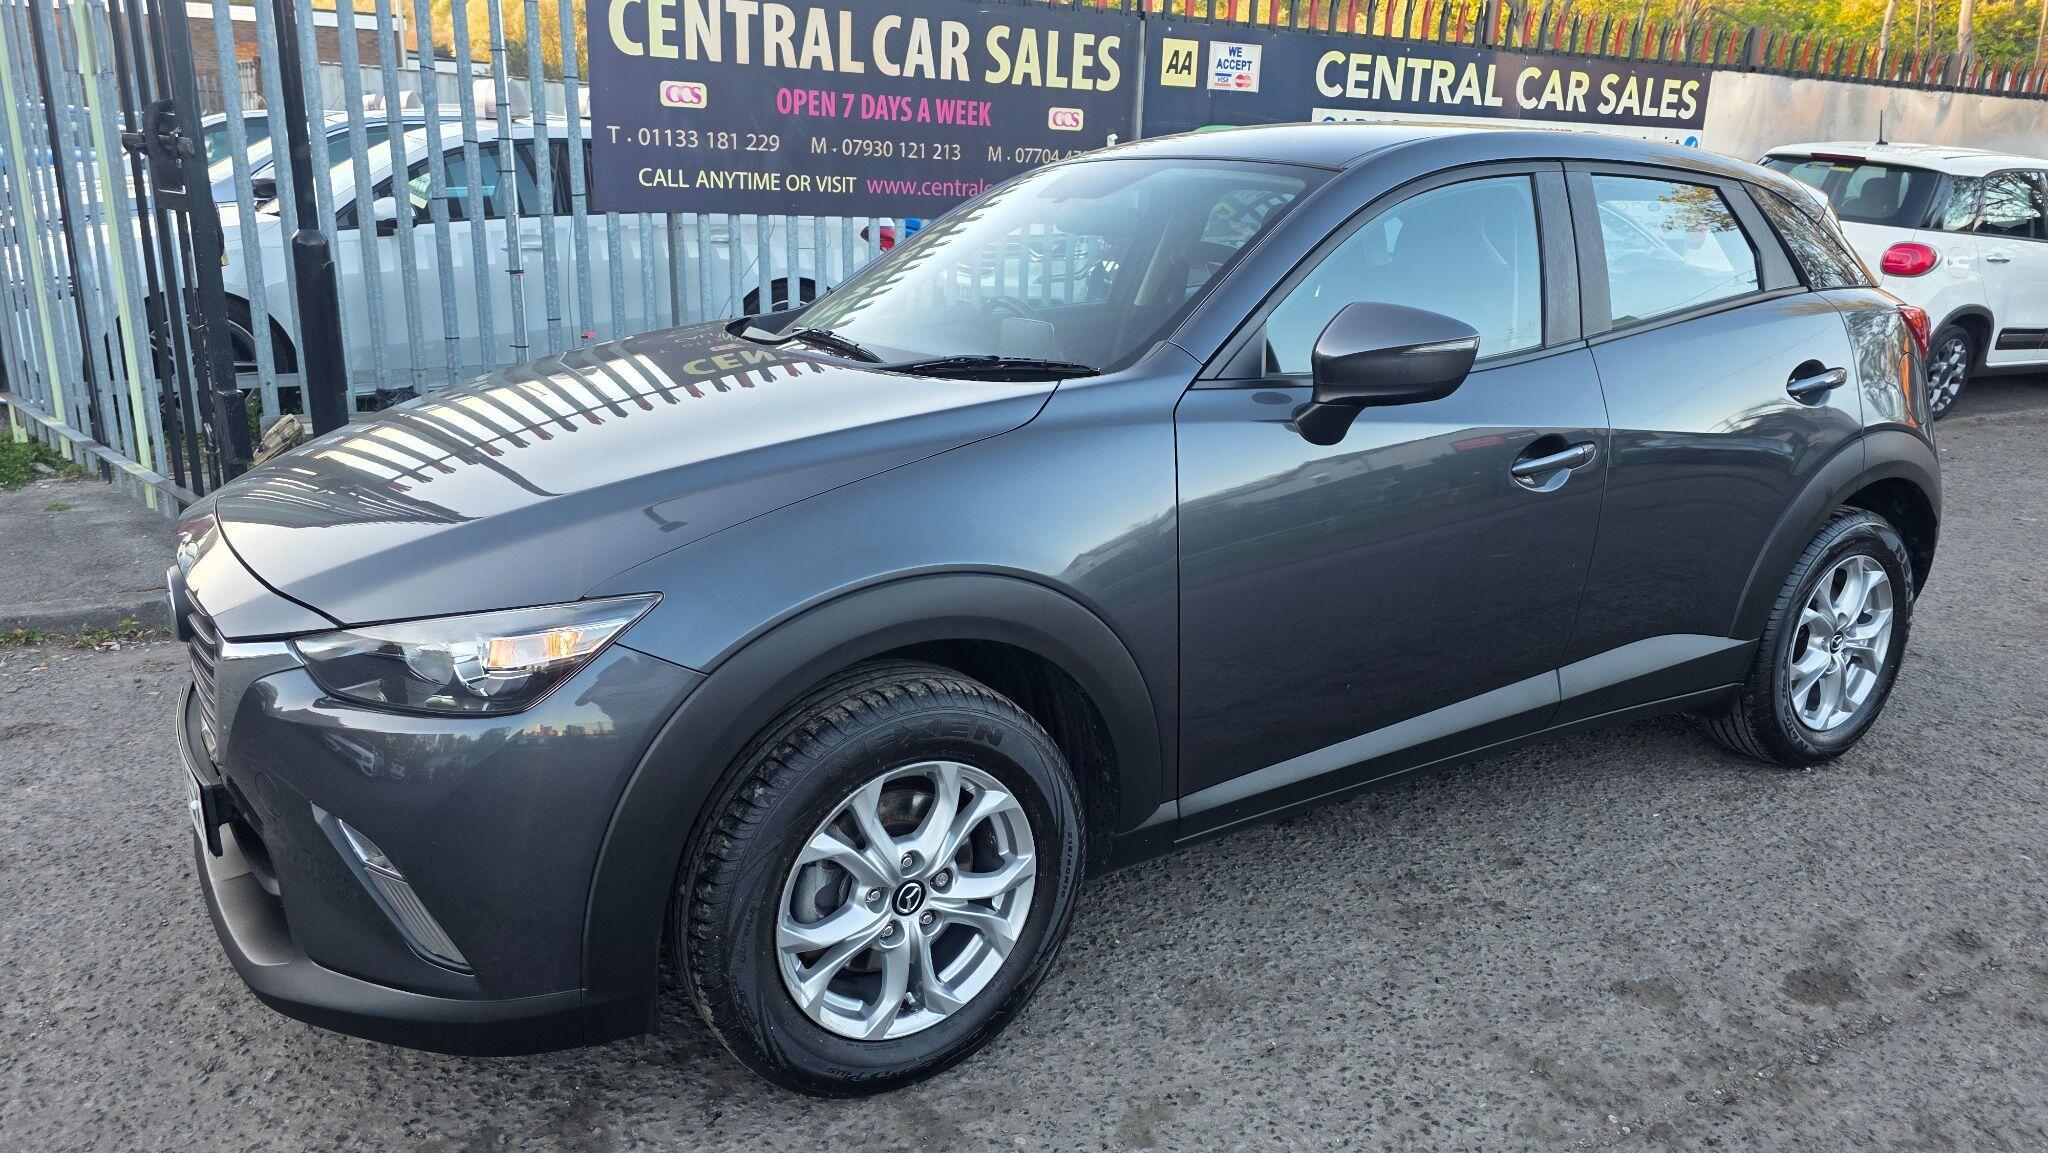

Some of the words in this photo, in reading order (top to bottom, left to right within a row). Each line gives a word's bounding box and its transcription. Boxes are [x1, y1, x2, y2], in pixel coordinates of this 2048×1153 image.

[608, 0, 865, 74] CENTRAL
[872, 14, 970, 81] CAR
[984, 25, 1121, 92] SALES
[1228, 46, 1243, 57] WE
[1165, 50, 1193, 76] AA
[1216, 58, 1253, 72] ACCEPT
[1315, 50, 1504, 107] CENTRAL
[1515, 66, 1590, 113] CAR
[1596, 73, 1700, 120] SALES
[777, 87, 835, 118] OPEN
[842, 93, 855, 118] 7
[861, 94, 912, 122] DAYS
[916, 97, 931, 122] A
[935, 98, 992, 127] WEEK
[638, 127, 699, 148] 01133
[707, 131, 737, 150] 181
[746, 133, 780, 152] 229
[842, 138, 893, 157] 07930
[900, 142, 926, 159] 121
[933, 143, 961, 160] 213
[1015, 148, 1059, 164] 07704
[638, 167, 690, 188] CALL
[695, 170, 781, 191] ANYTIME
[785, 174, 811, 192] OR
[815, 175, 858, 193] VISIT
